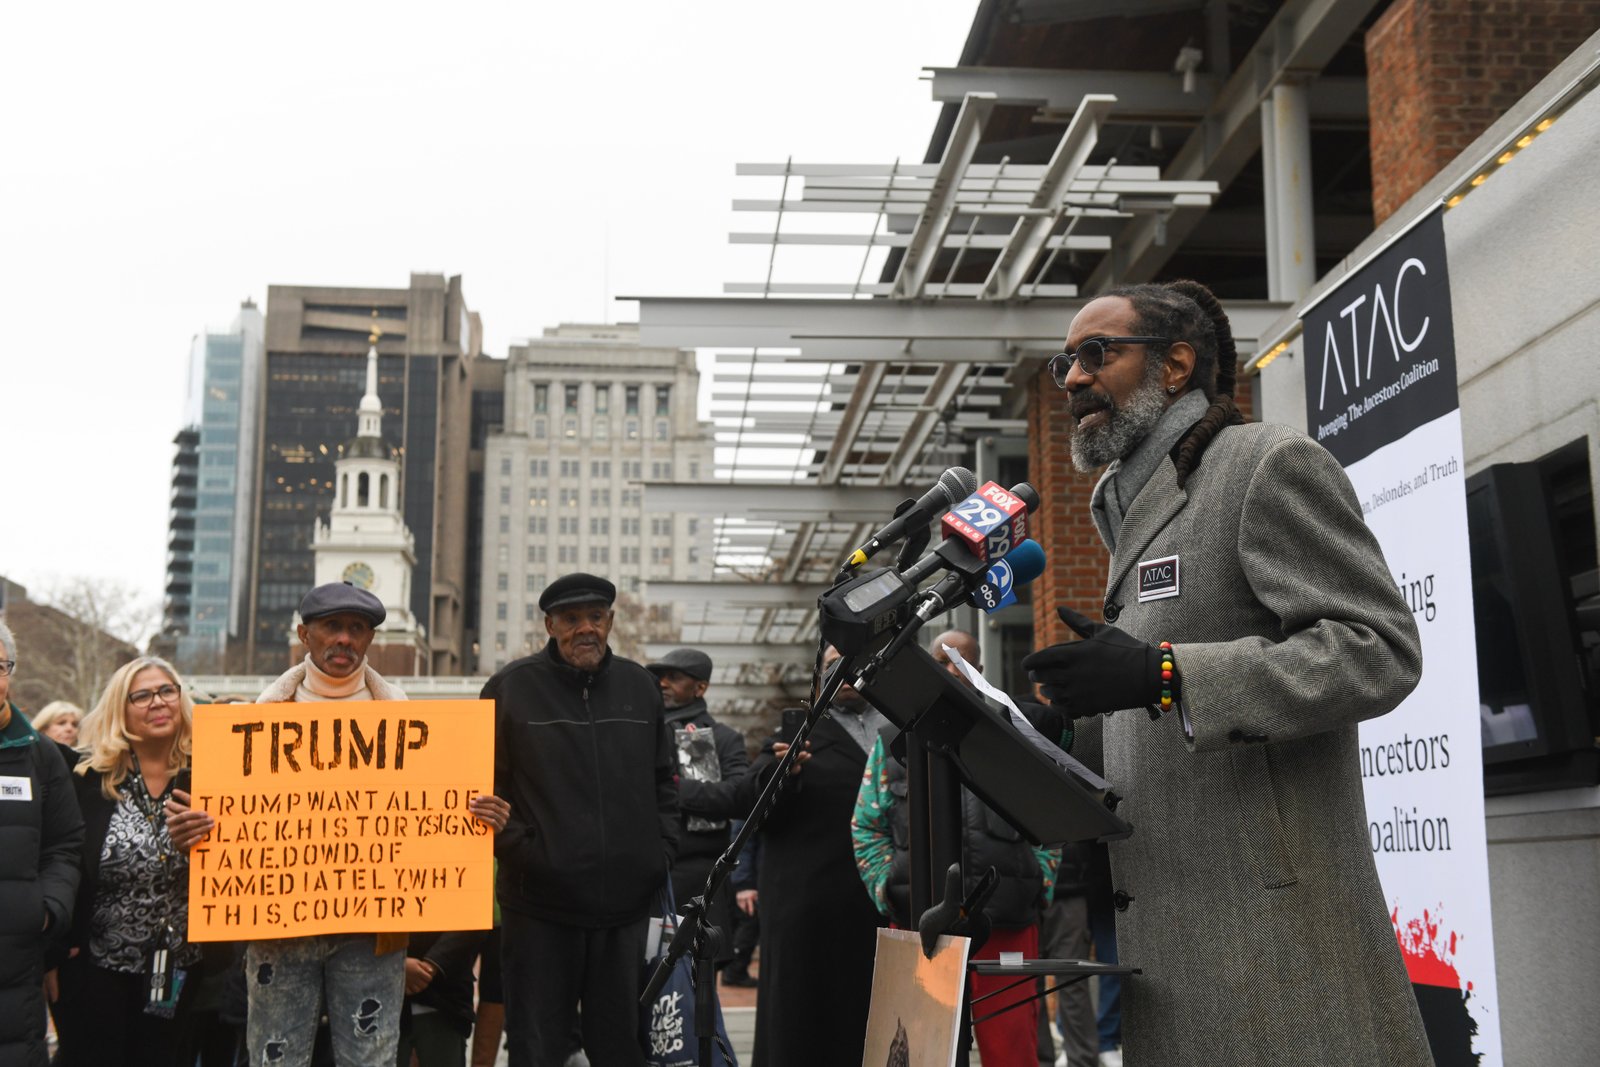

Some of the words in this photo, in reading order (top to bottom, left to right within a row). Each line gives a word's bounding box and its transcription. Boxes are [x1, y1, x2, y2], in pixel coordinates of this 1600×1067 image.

[1319, 258, 1430, 411] ATAC
[1318, 414, 1348, 440] Avenging
[1347, 403, 1363, 421] The
[1363, 381, 1401, 413] Ancestors
[1400, 358, 1439, 390] Coalition
[1413, 467, 1428, 490] and
[1429, 456, 1458, 481] Truth
[955, 499, 1002, 527] 29
[983, 486, 1018, 511] FOX
[947, 515, 981, 539] NEWS
[989, 524, 1010, 559] 29
[1013, 512, 1026, 546] FOX
[1143, 565, 1171, 583] ATAC
[980, 584, 996, 608] abc
[231, 718, 429, 777] TRUMP
[1361, 733, 1450, 778] ncestors
[386, 790, 434, 812] ALL
[1369, 806, 1451, 853] oalition
